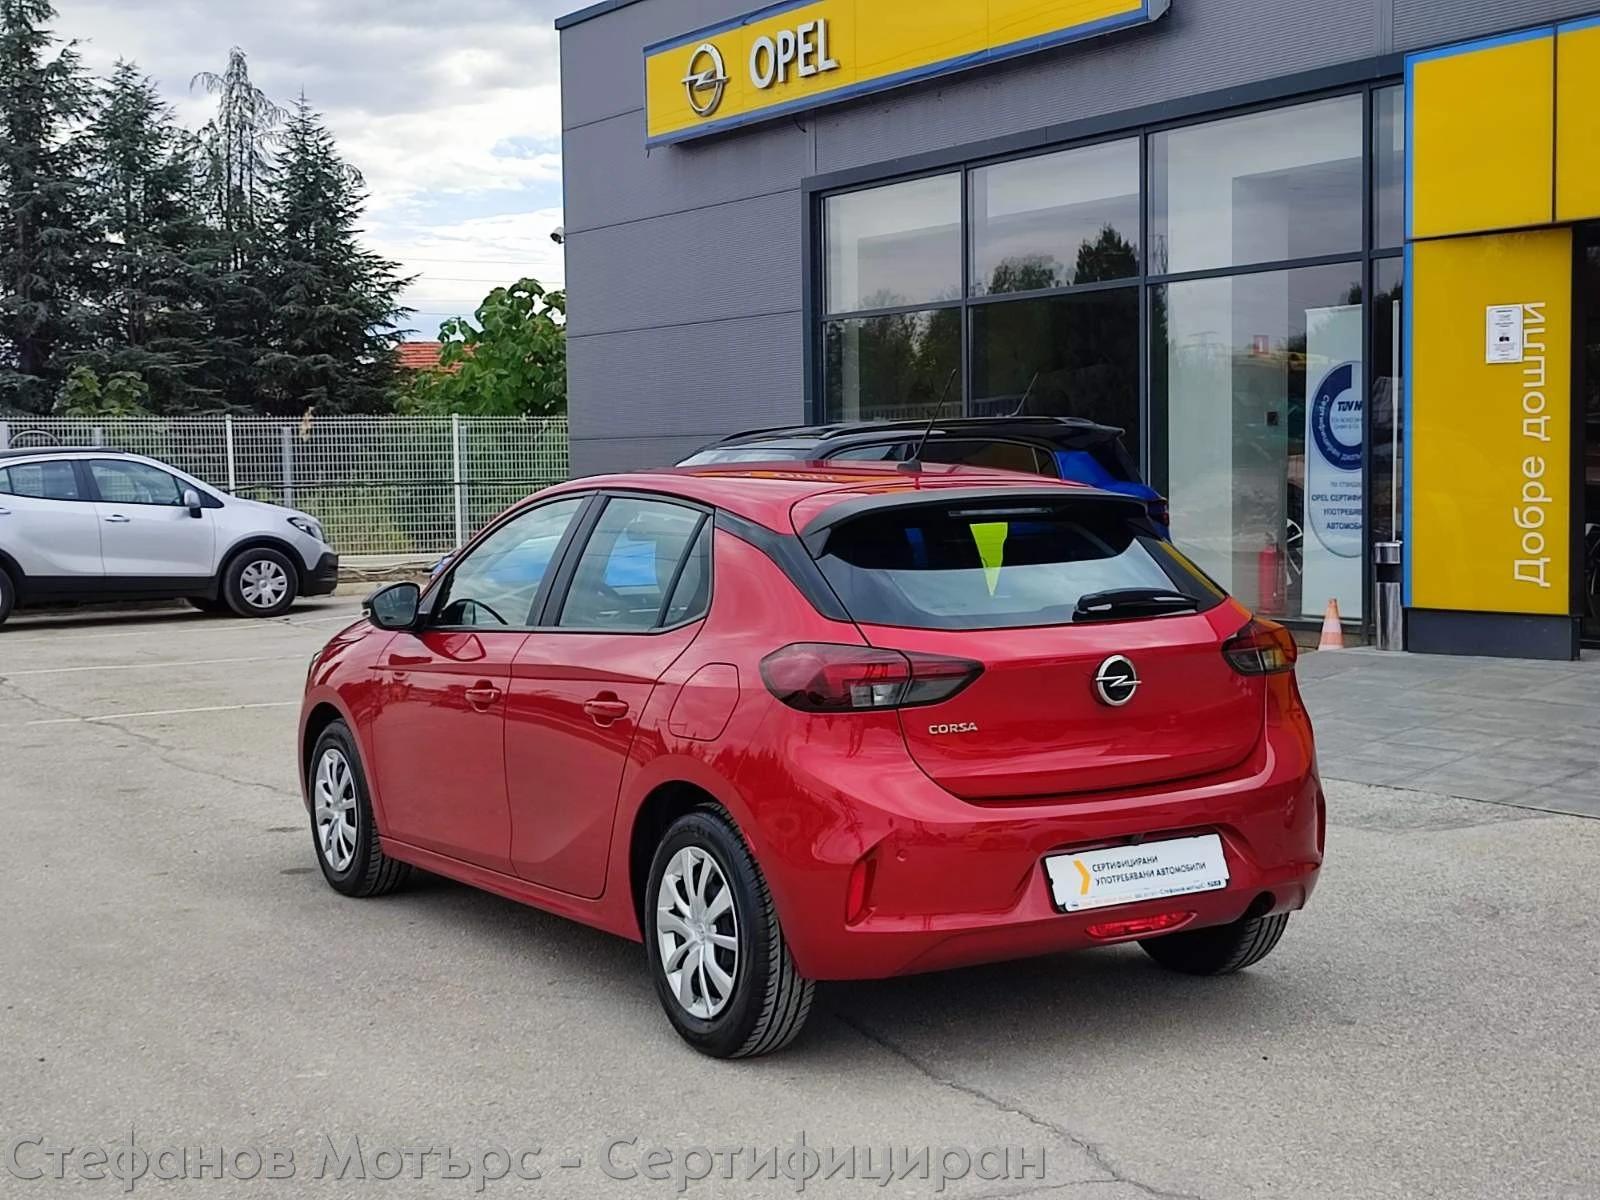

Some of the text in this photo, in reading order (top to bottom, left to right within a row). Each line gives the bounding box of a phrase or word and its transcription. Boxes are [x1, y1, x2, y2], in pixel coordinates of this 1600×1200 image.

[750, 18, 840, 89] OPEL
[1514, 301, 1552, 588] Добре дошли
[928, 721, 978, 735] CORSA
[1092, 855, 1158, 873] СЕРТИФИЦИРАНИ
[1095, 862, 1207, 886] УПОТРЕБЯВАНИ АВТОМОБИЛИ
